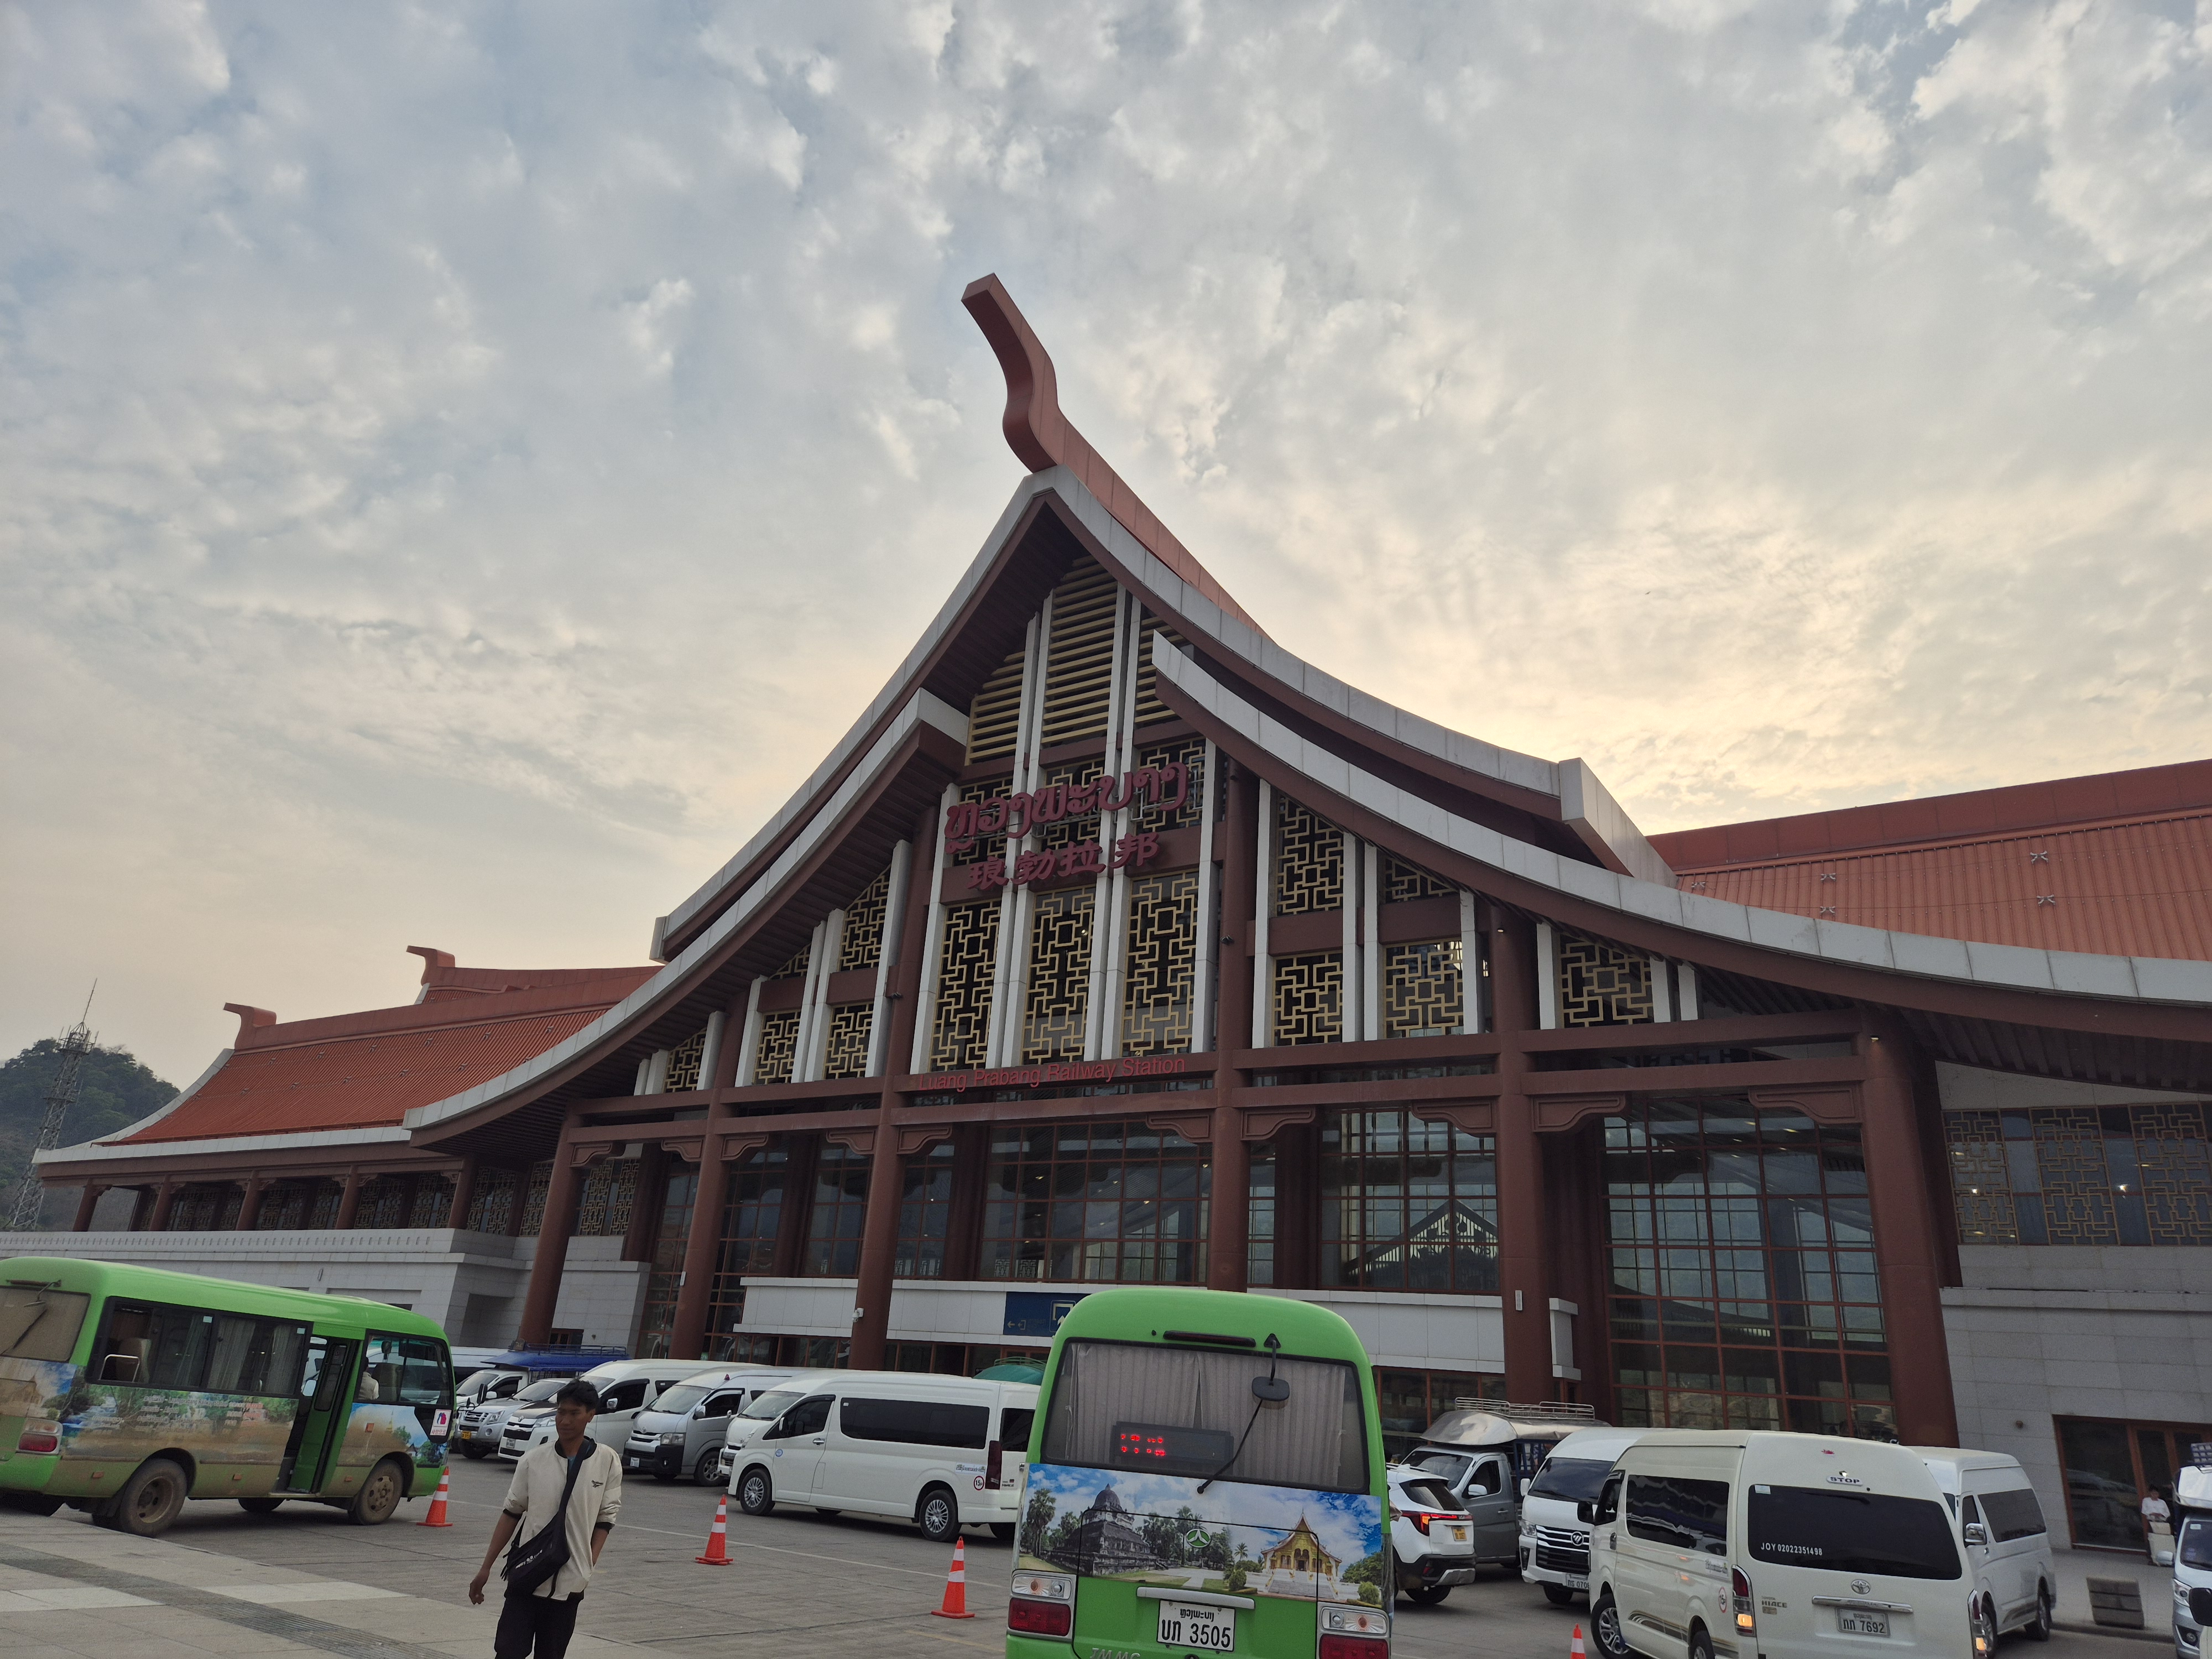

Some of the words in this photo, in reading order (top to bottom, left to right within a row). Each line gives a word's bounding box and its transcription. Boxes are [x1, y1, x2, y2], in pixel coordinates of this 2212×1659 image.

[968, 832, 1160, 890] 琅勃拉邦
[919, 1073, 967, 1093] Luang
[973, 1068, 1041, 1088] Prabang
[1047, 1062, 1117, 1082] Railway
[1121, 1056, 1186, 1077] Station
[1761, 1542, 1776, 1551] JOY
[1777, 1544, 1823, 1556] 02022351498
[1761, 1600, 1787, 1608] HIACE
[1190, 1623, 1230, 1648] 3505
[1860, 1621, 1886, 1634] 7692
